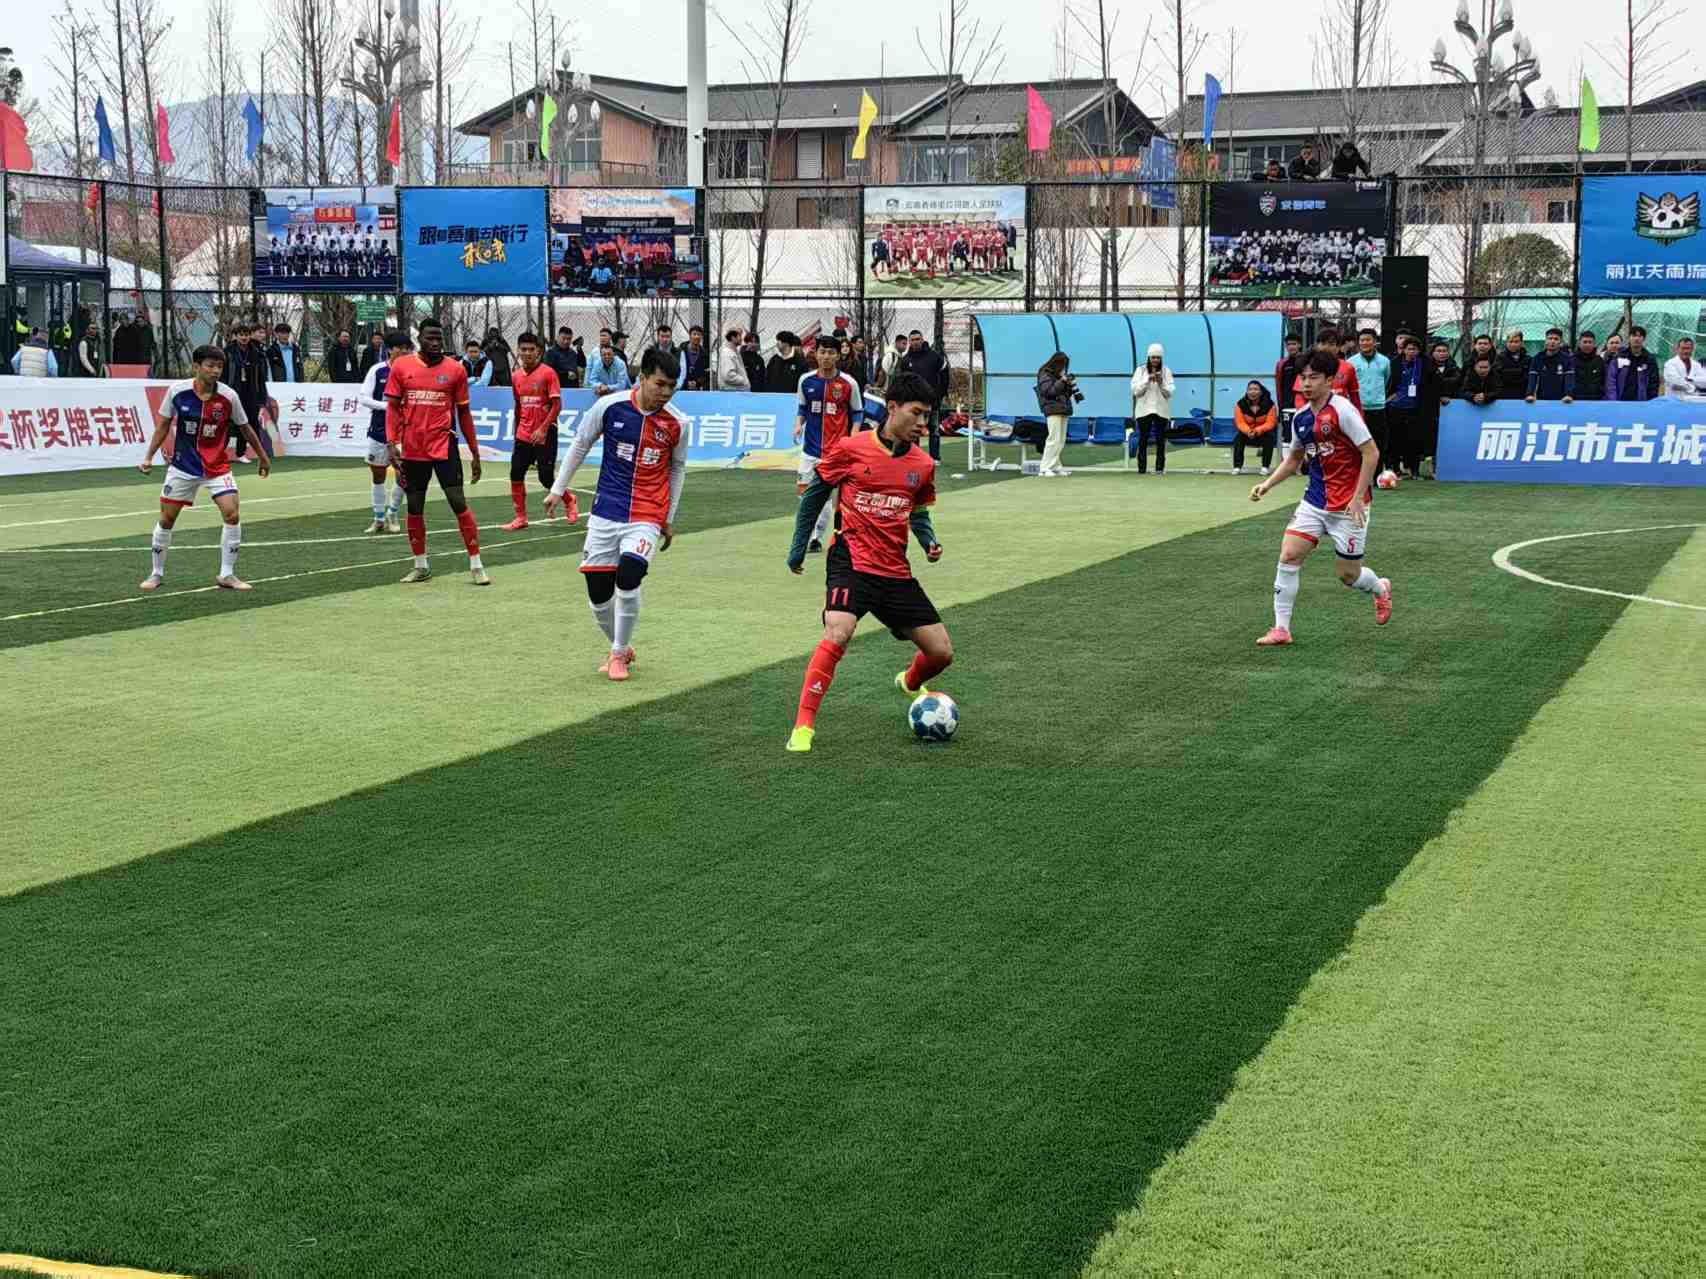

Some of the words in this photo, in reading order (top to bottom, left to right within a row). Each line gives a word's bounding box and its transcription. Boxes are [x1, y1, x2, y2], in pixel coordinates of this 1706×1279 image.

[291, 396, 359, 413] 关键时
[288, 422, 354, 439] 守护生
[831, 587, 849, 607] 11
